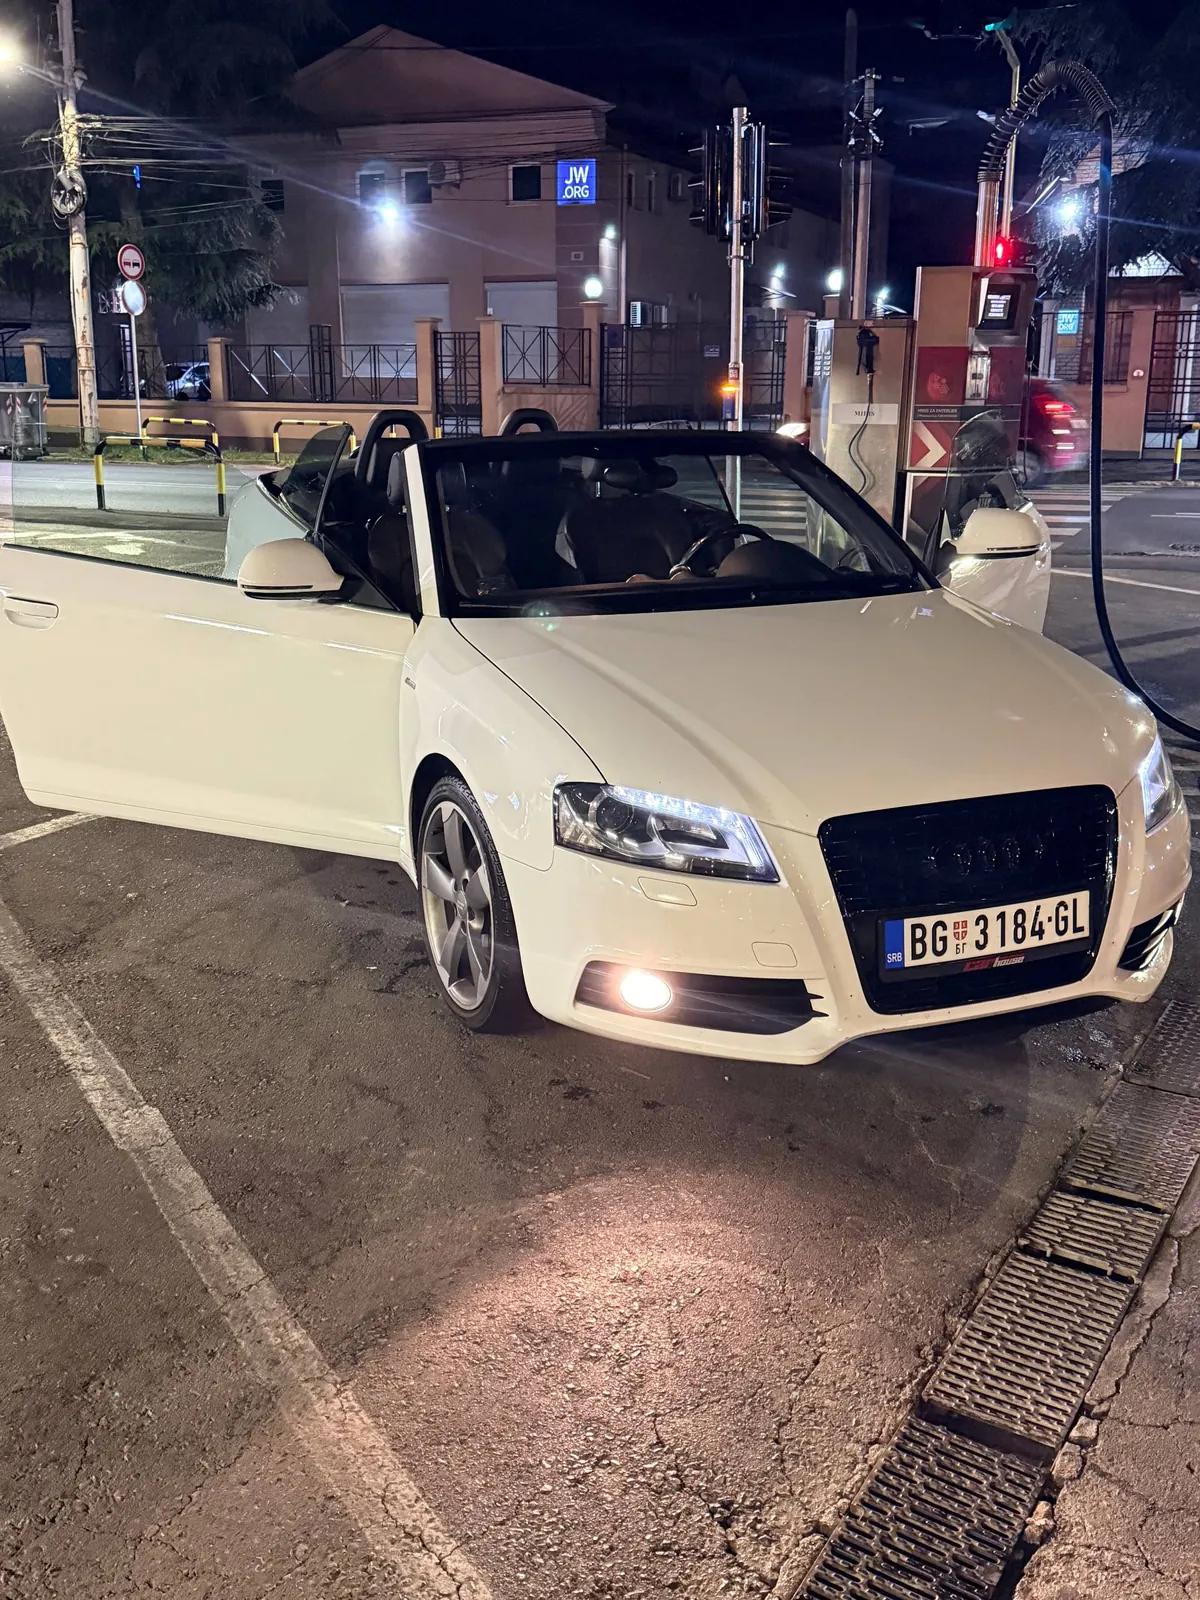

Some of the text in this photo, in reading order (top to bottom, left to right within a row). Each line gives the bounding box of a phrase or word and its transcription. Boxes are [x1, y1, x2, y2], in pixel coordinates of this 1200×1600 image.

[565, 165, 589, 185] JW
[563, 185, 590, 199] .ORG
[910, 920, 948, 961] BG
[886, 952, 903, 964] SRB
